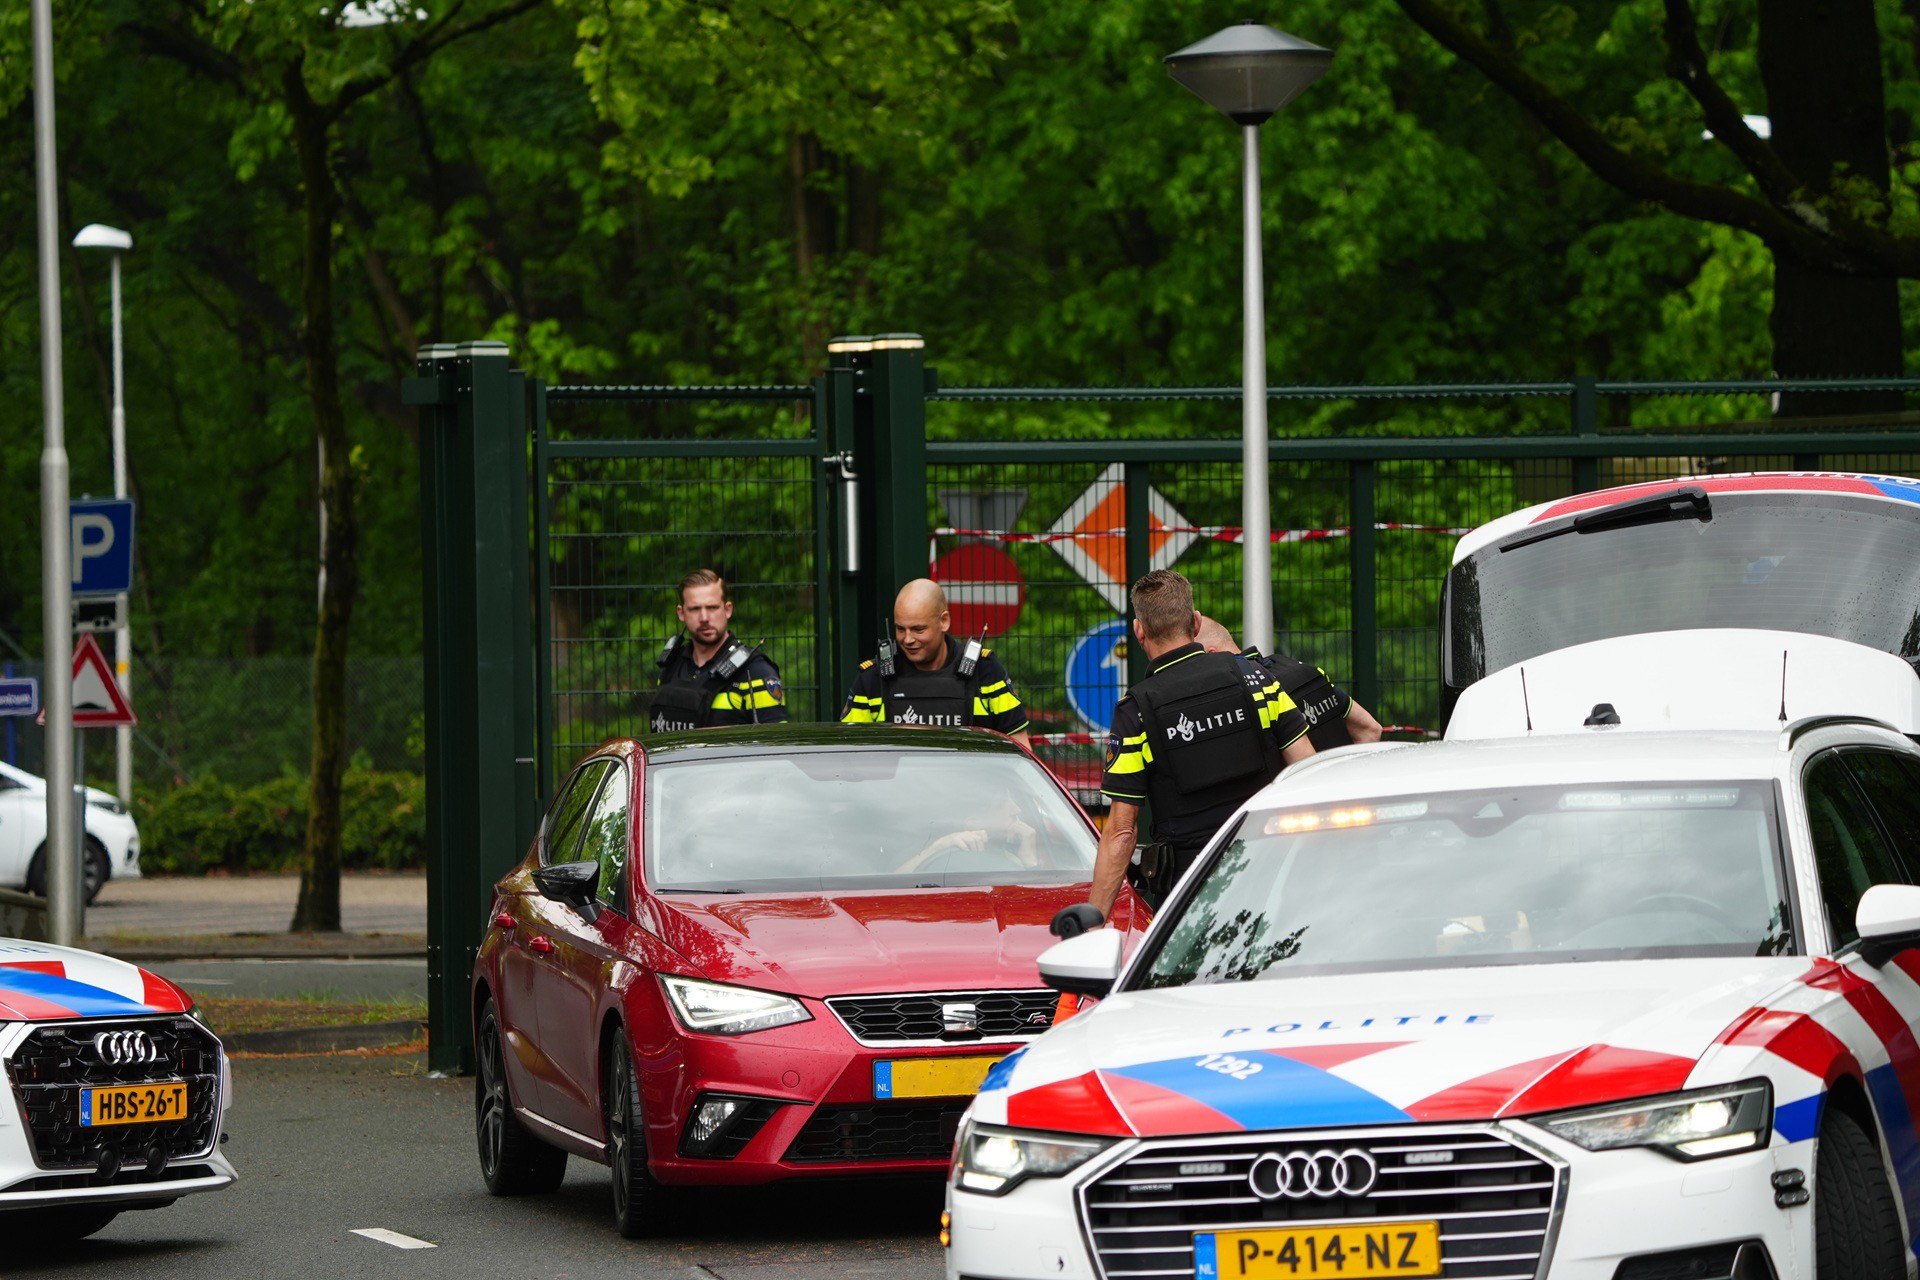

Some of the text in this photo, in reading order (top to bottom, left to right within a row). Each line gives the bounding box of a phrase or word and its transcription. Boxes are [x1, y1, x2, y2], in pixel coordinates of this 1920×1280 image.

[71, 513, 115, 584] P
[1166, 708, 1246, 742] POLITIE
[1221, 1014, 1496, 1038] POLITIE
[1194, 1053, 1263, 1081] 1292
[81, 1088, 183, 1120] NL HBS-26-T
[877, 1083, 890, 1093] NL
[1198, 1231, 1420, 1276] NL P-414-NZ
